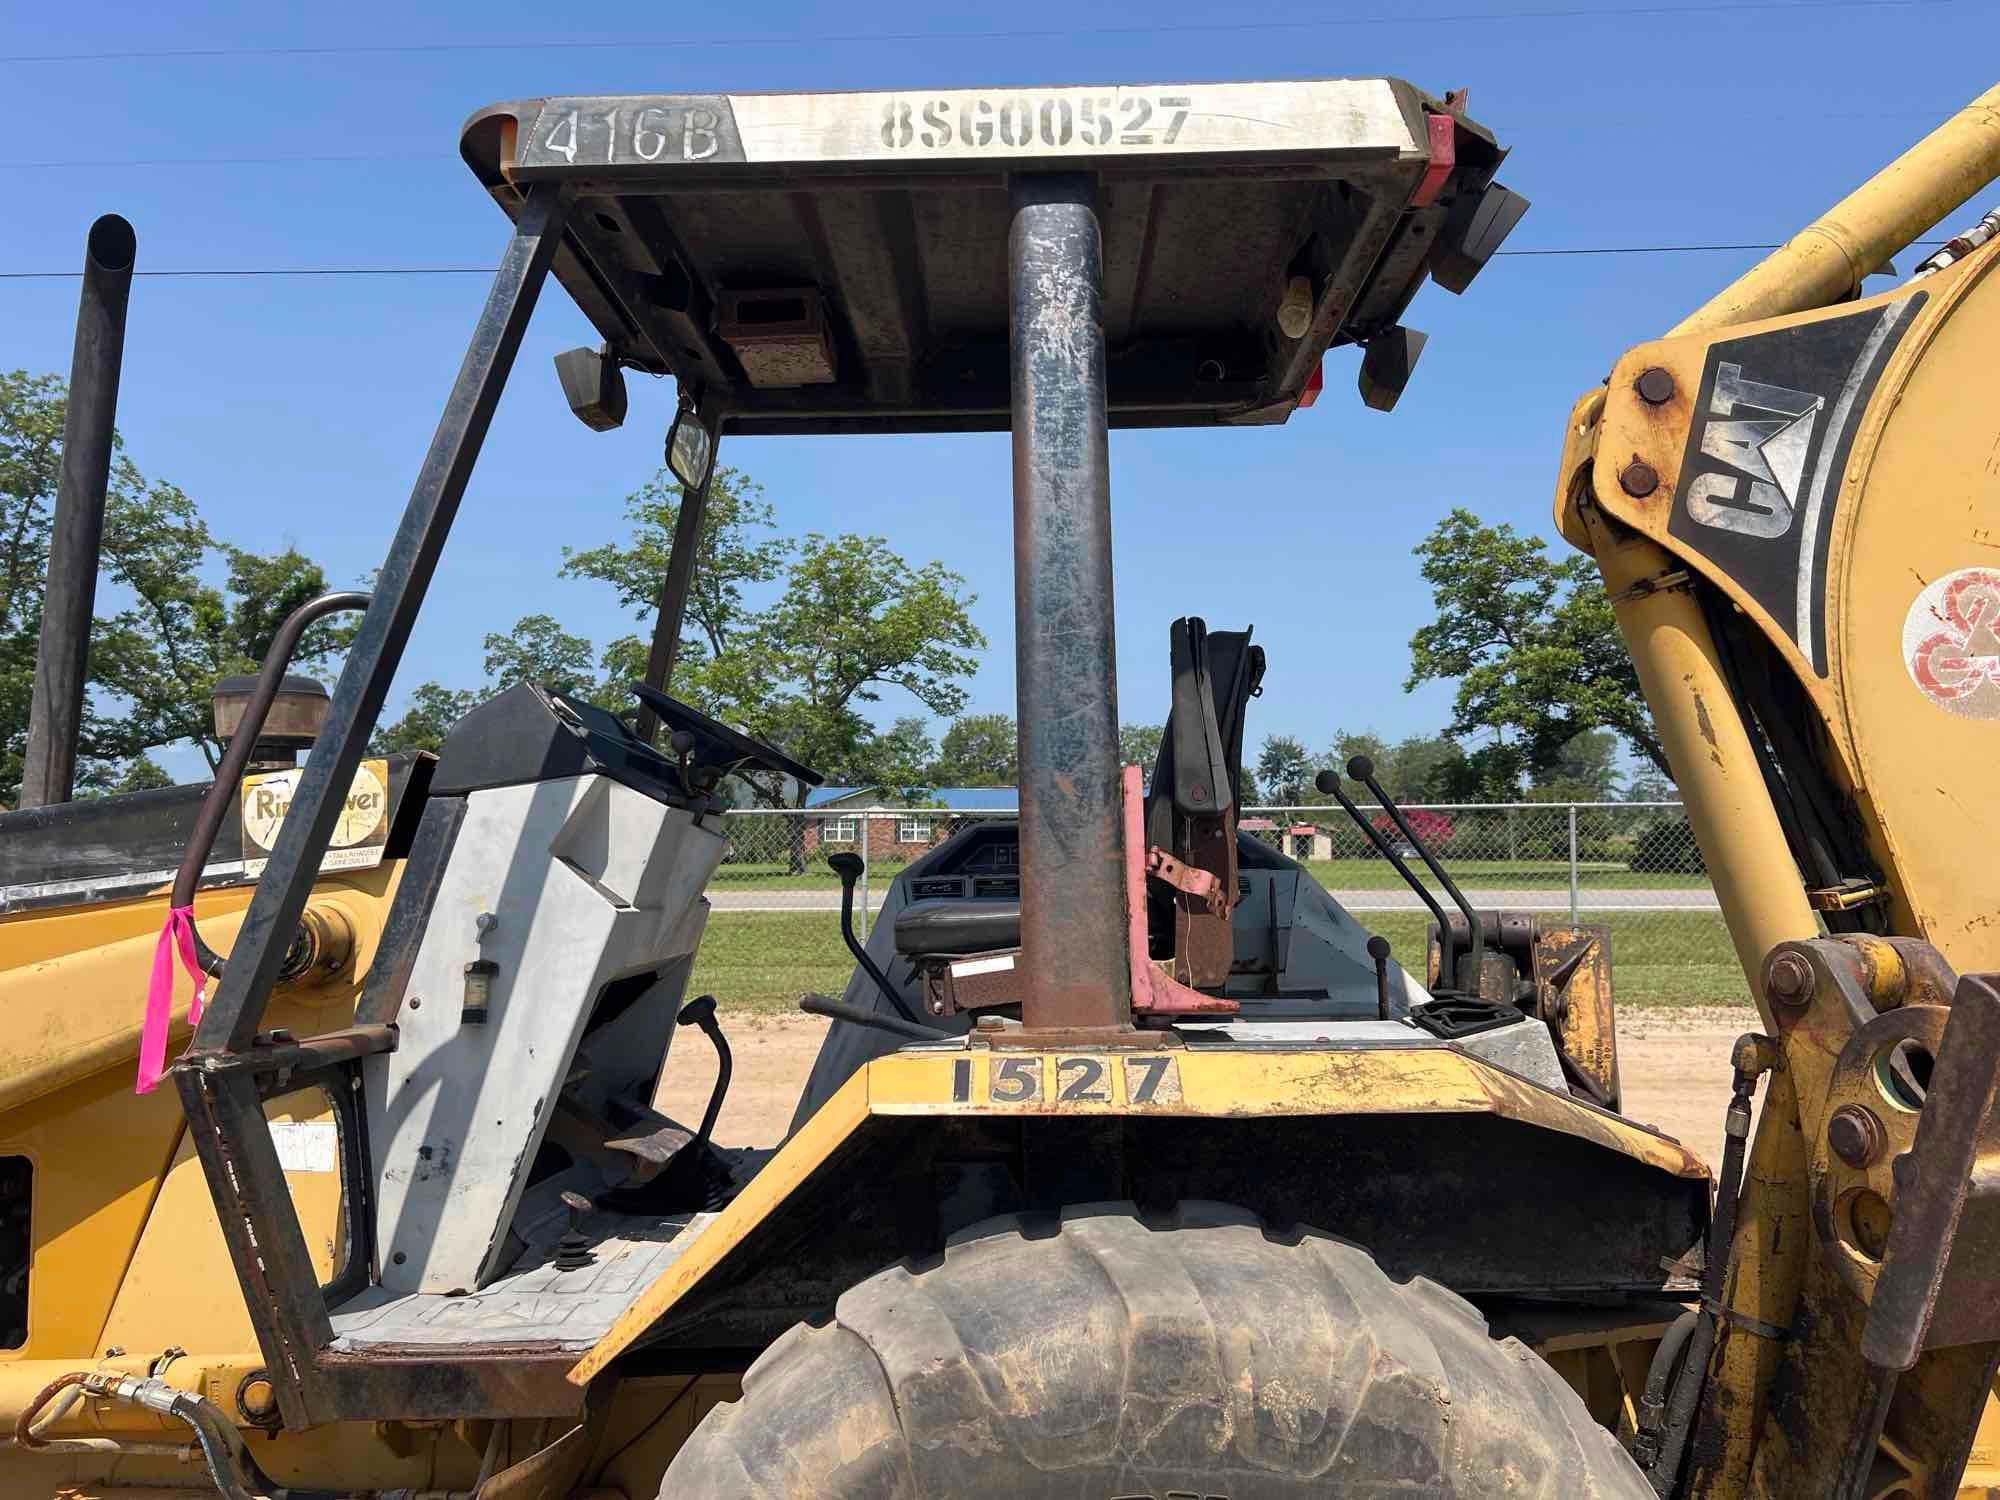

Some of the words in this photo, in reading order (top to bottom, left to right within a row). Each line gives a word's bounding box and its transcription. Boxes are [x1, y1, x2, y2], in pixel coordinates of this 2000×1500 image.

[545, 109, 719, 163] 416B
[881, 97, 1191, 148] 8SG00527
[1687, 361, 1825, 539] CAT
[953, 1057, 1172, 1102] 1527
